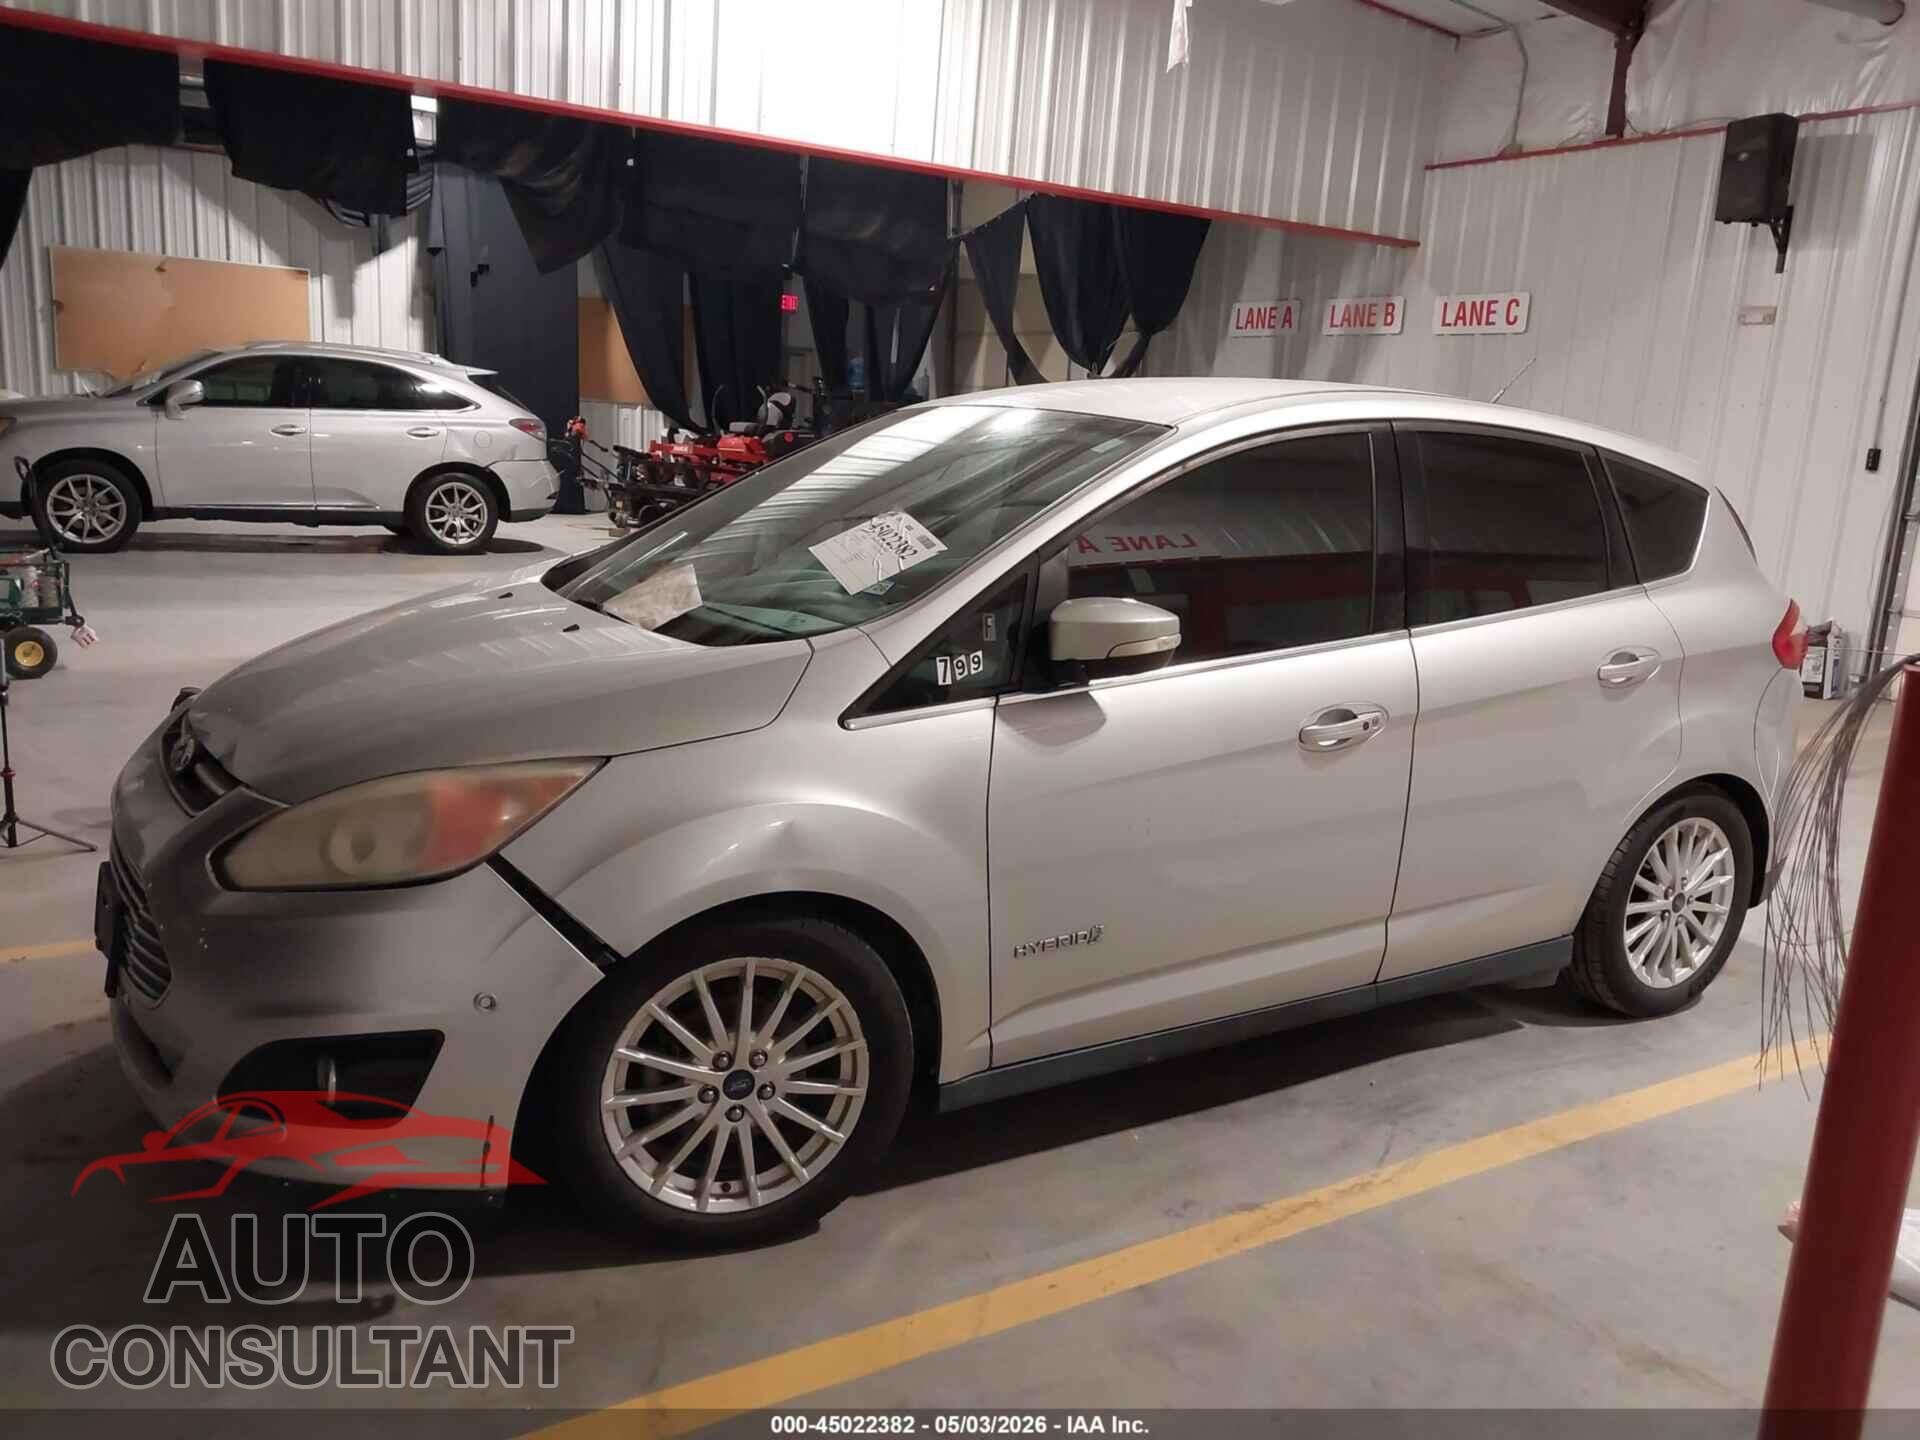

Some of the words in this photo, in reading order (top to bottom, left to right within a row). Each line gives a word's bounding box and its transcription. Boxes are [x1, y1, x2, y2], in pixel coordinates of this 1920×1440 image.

[1235, 306, 1277, 330] LANE
[1281, 306, 1293, 329] A
[1329, 302, 1376, 328] LANE
[1383, 301, 1396, 327] B
[1441, 299, 1499, 327] LANE
[1505, 298, 1521, 326] C
[938, 653, 981, 684] 799
[1013, 930, 1089, 958] HYBRID
